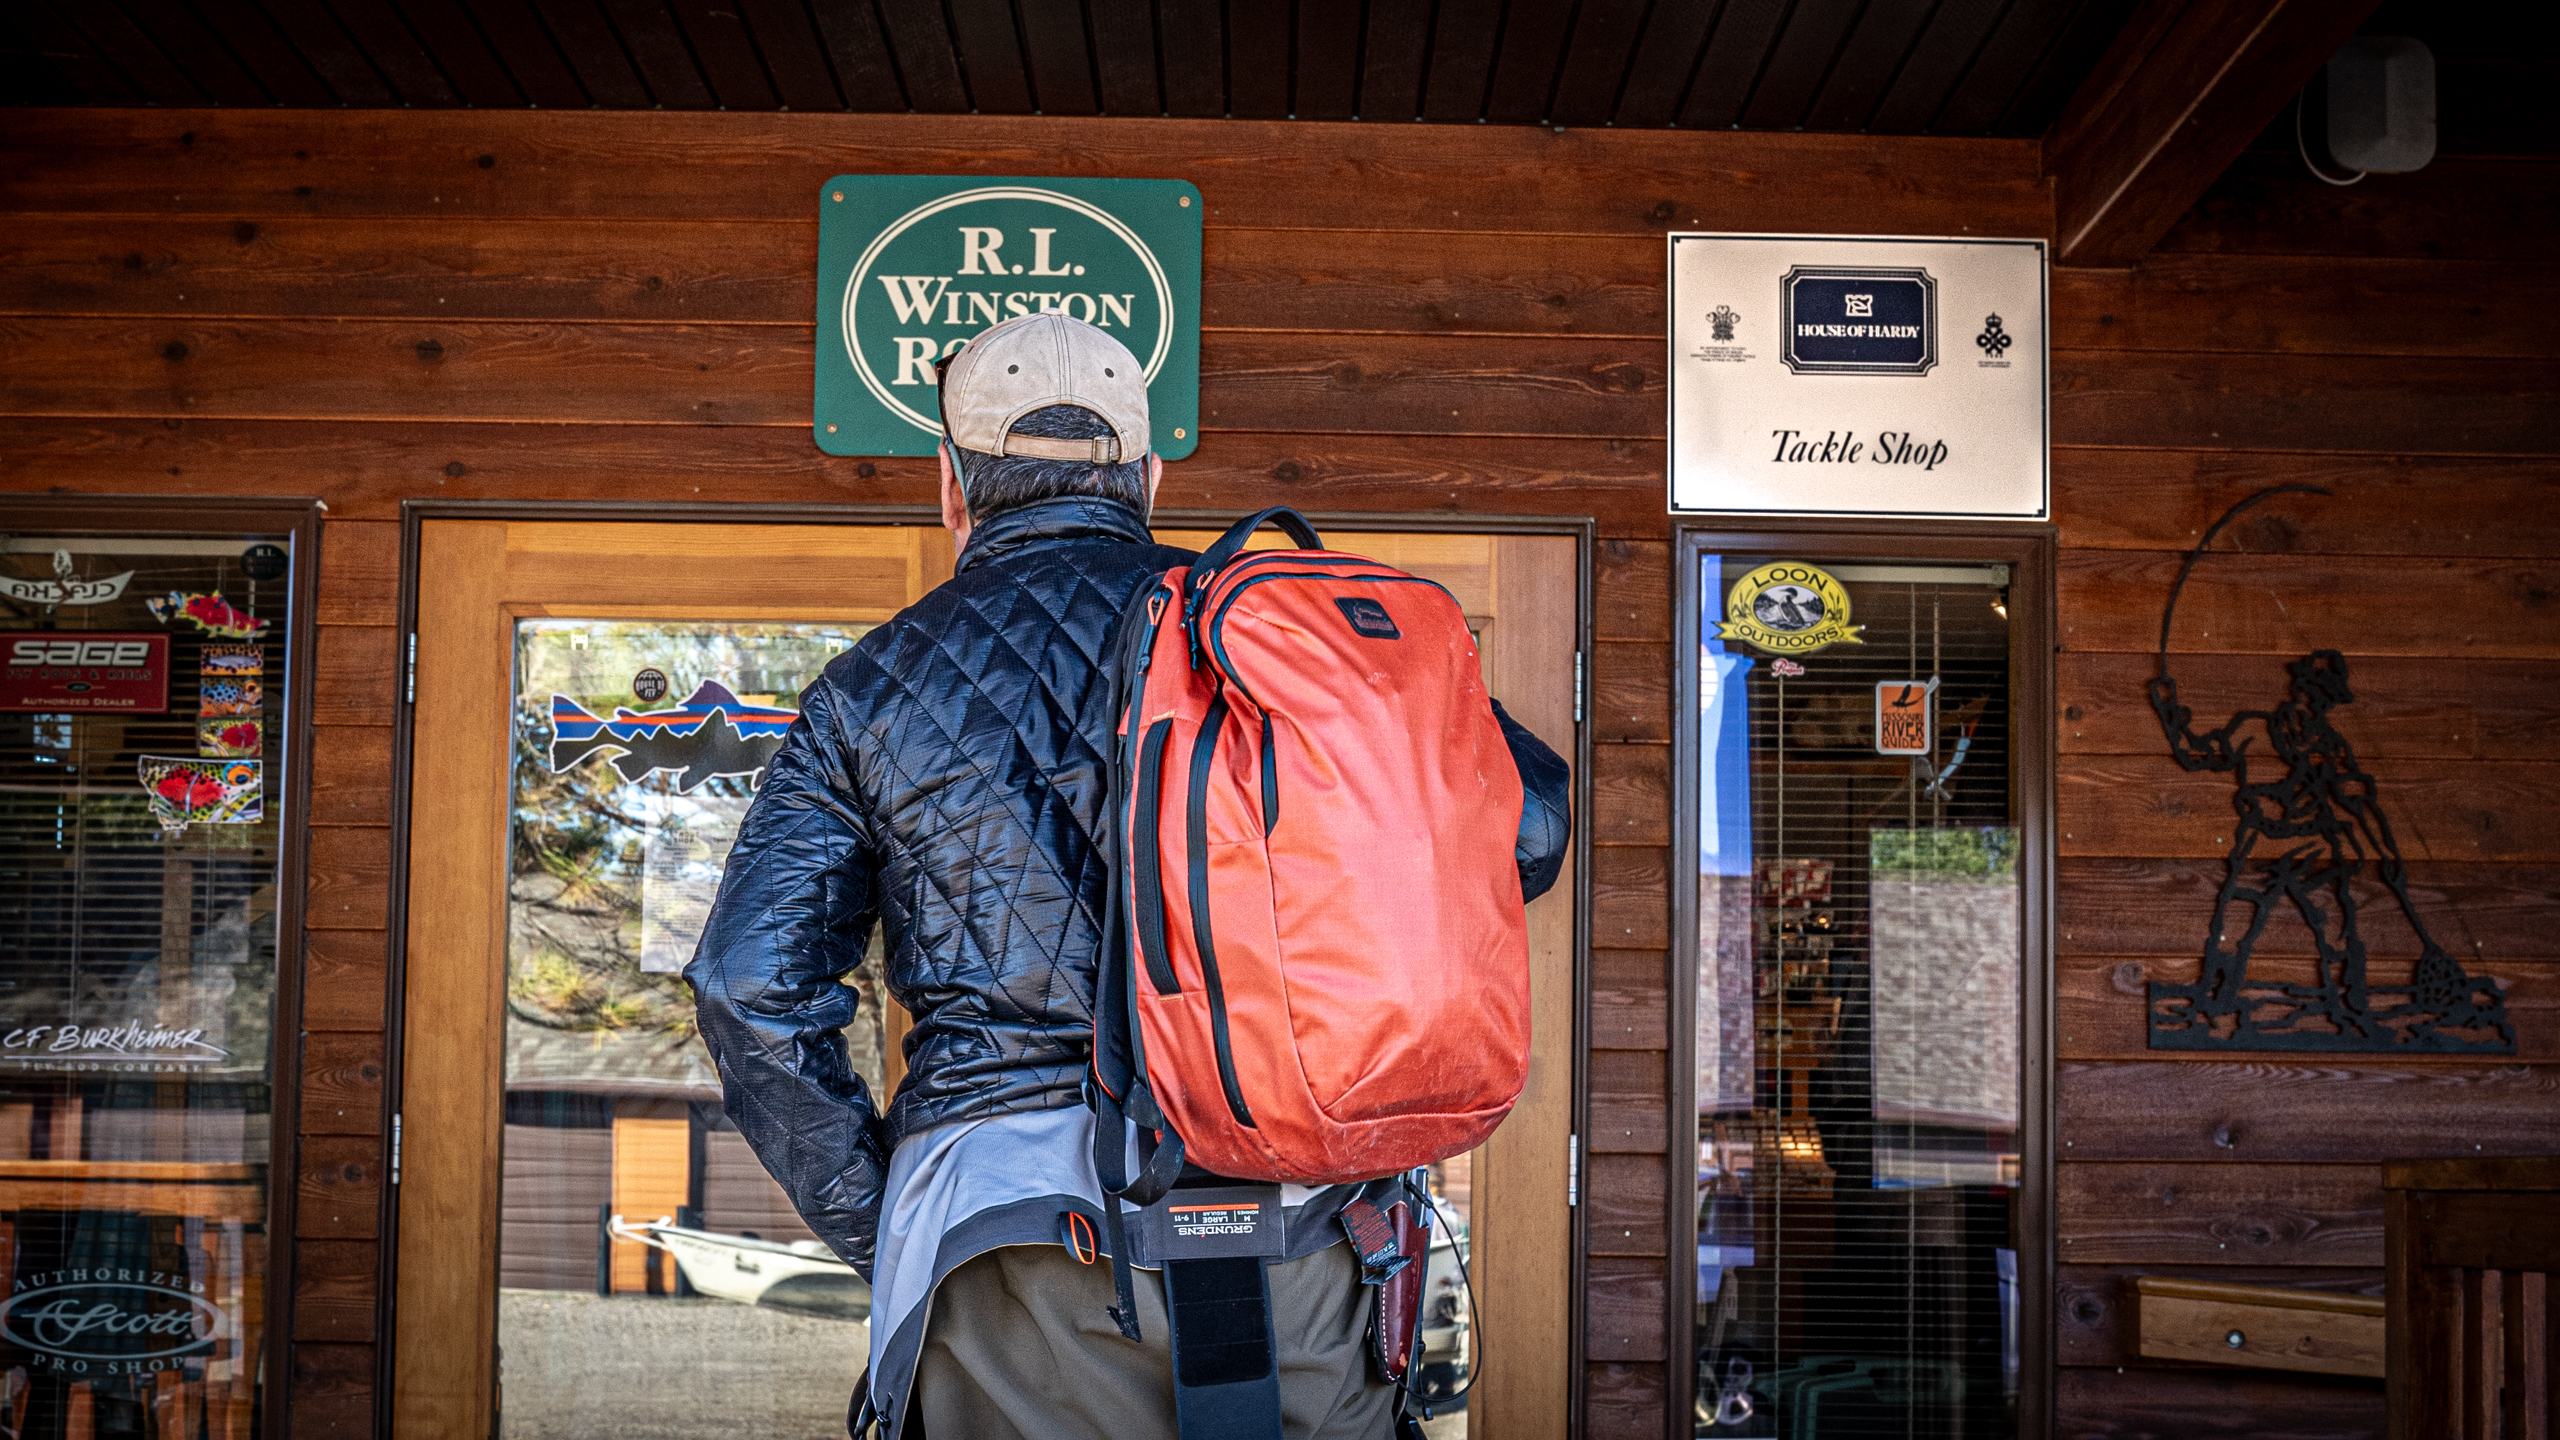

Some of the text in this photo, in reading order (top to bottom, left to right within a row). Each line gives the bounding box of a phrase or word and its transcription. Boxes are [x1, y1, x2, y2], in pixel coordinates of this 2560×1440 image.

[957, 226, 1086, 277] R.L.
[877, 275, 1136, 330] WINSTON
[1797, 324, 1920, 339] HOUSE OF HARDY
[1771, 429, 1949, 471] Tackle Shop
[1752, 567, 1828, 592] LOON
[1739, 624, 1839, 648] OUTDOORS
[1881, 721, 1925, 738] RIVER
[1881, 736, 1925, 750] GUIDES
[2, 1026, 52, 1049] CF
[113, 1062, 201, 1073] COMPANY
[1202, 1216, 1228, 1224] LARGE
[14, 1268, 205, 1293] AUTHORIZED
[32, 1353, 184, 1375] PRO SHOP
